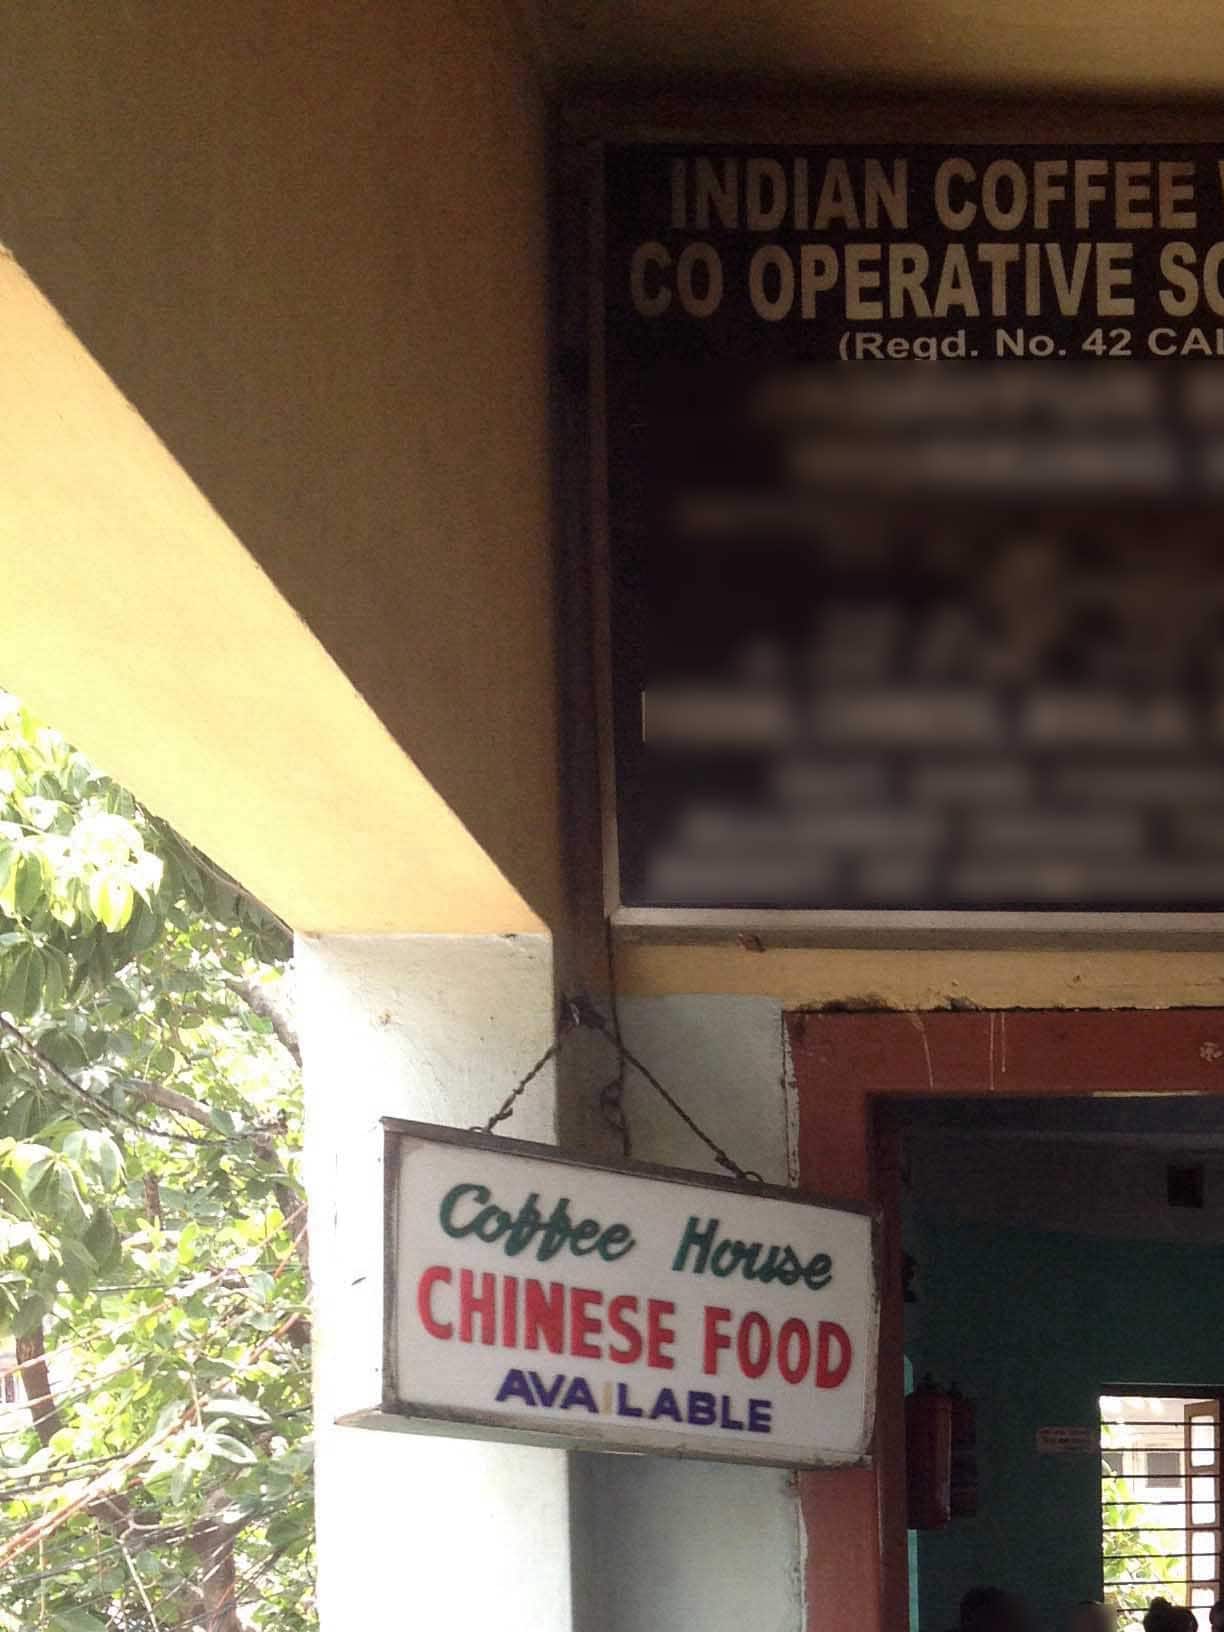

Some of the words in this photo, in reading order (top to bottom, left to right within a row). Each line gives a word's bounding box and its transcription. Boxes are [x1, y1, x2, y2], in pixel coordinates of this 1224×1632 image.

[671, 157, 910, 232] INDIAN
[933, 157, 1198, 232] COFFEE
[629, 240, 725, 320] CO
[748, 241, 1136, 321] OPERATIVE
[838, 328, 979, 361] (Regd.
[995, 328, 1068, 357] No.
[1081, 328, 1132, 357] 42
[438, 1182, 637, 1262] Coffee
[671, 1215, 834, 1291] House
[416, 1265, 676, 1370] CHINESE
[703, 1304, 853, 1390] FOOD
